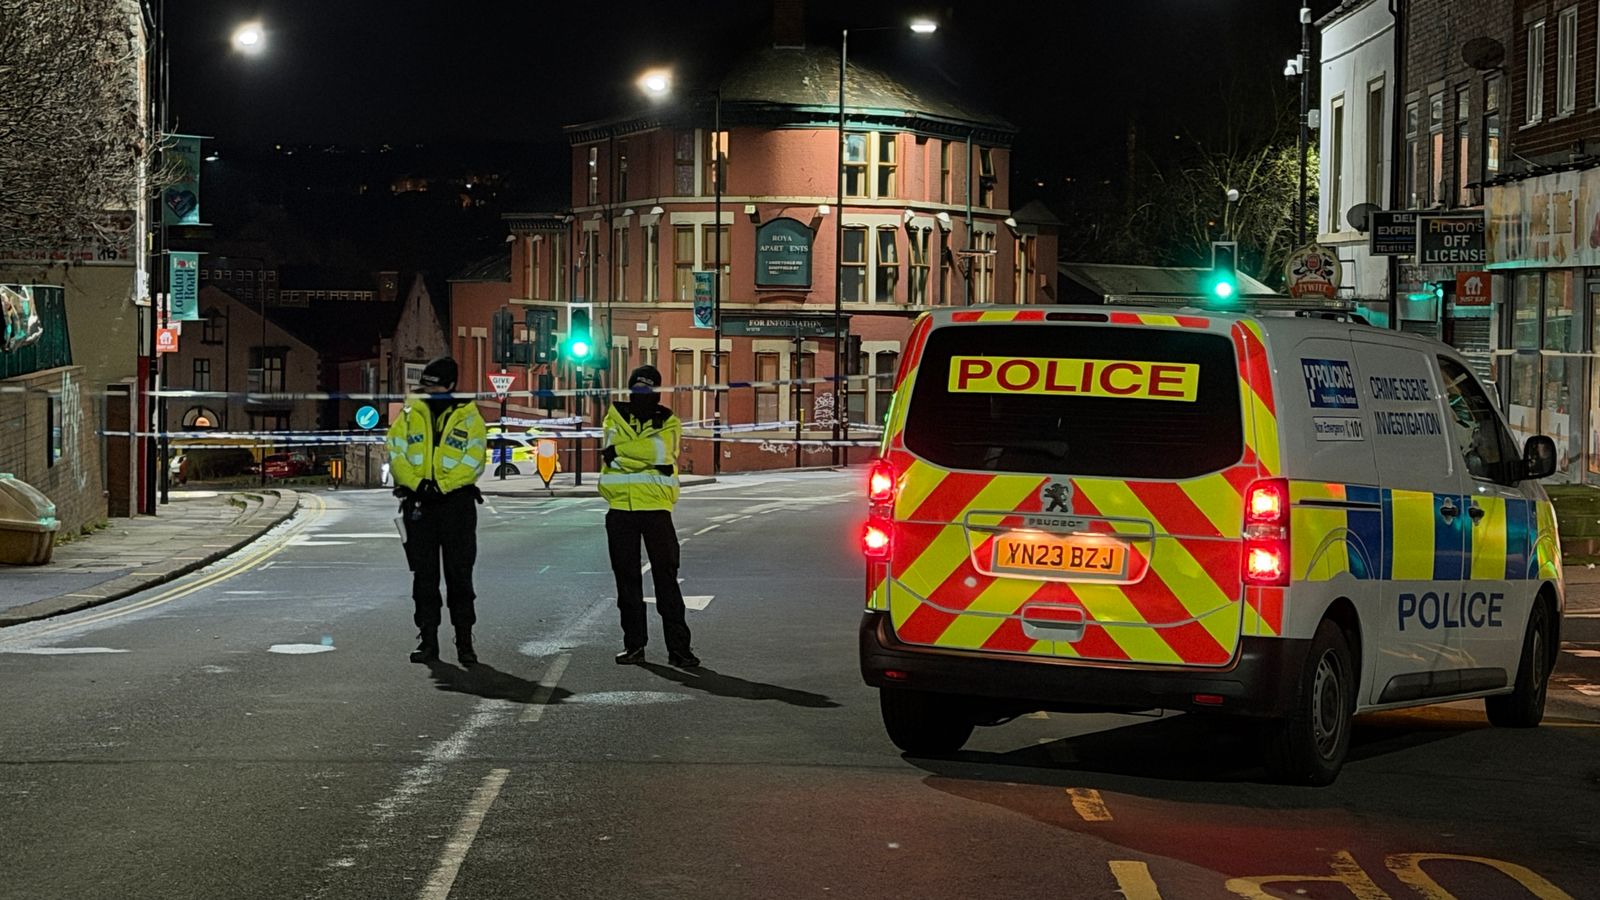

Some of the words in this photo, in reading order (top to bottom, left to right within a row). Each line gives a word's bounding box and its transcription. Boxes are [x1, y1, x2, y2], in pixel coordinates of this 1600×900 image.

[1393, 214, 1416, 223] DEL
[1444, 235, 1471, 247] OFF
[1426, 249, 1487, 262] LICENSE
[172, 269, 184, 315] London
[184, 268, 196, 300] Road
[749, 319, 765, 327] FOR
[766, 319, 822, 328] INFORMATION
[492, 377, 511, 385] GIVE
[957, 359, 1186, 398] POLICE
[1314, 364, 1354, 389] POLICING
[1370, 376, 1401, 400] CRIME
[1400, 378, 1431, 401] SCENE
[1350, 420, 1365, 438] 101
[1374, 411, 1442, 436] INVESTIGATION
[1028, 518, 1084, 528] PEUGEOT
[1008, 542, 1064, 567] YN23
[1069, 546, 1114, 570] BZJ
[1398, 591, 1505, 631] POLICE
